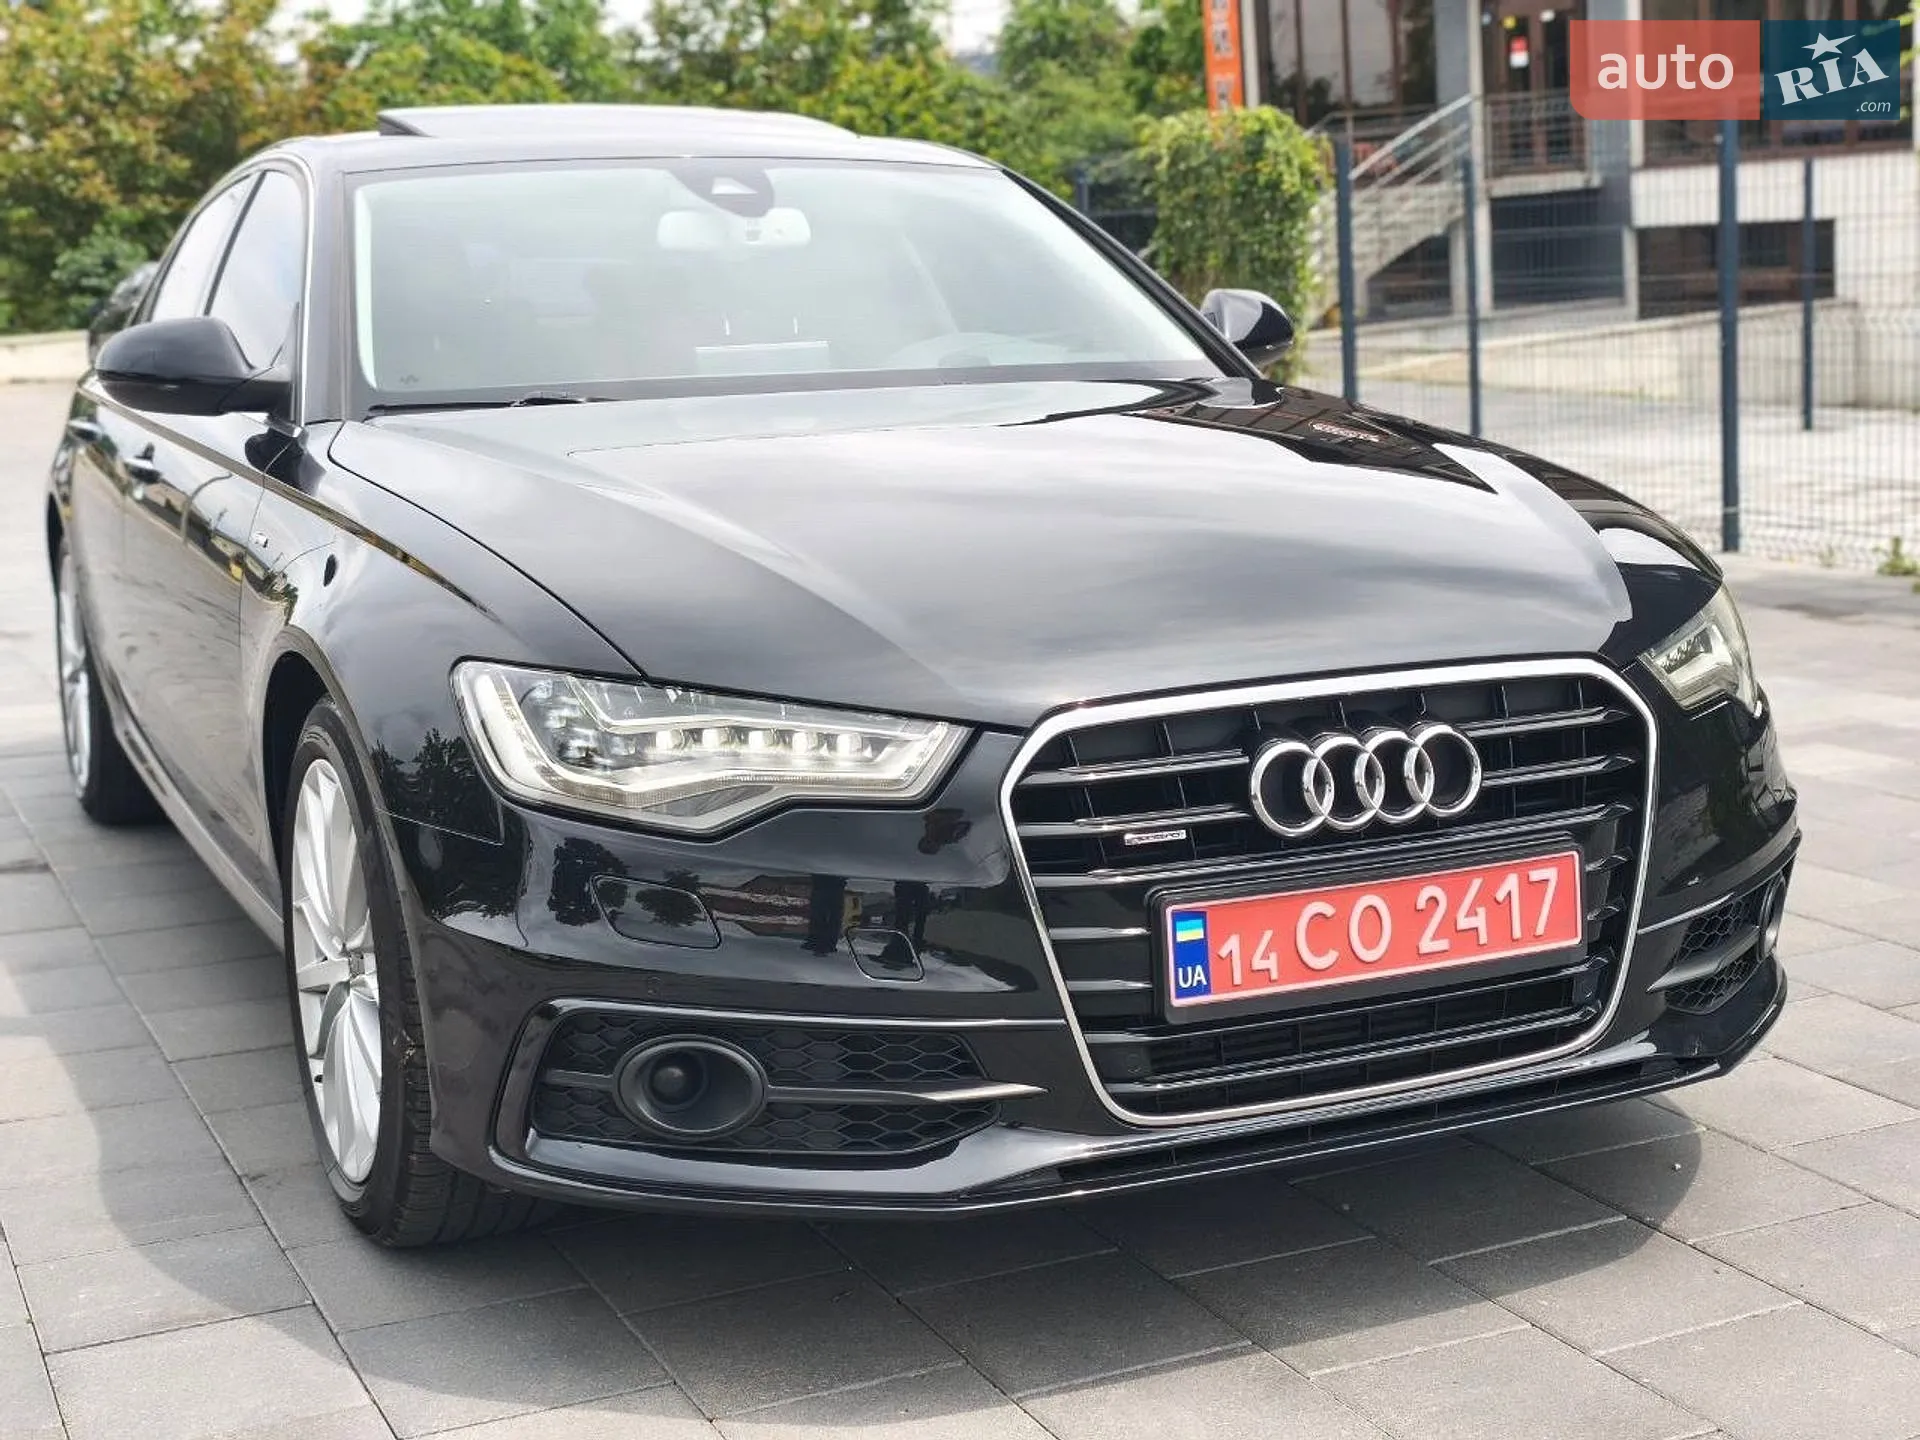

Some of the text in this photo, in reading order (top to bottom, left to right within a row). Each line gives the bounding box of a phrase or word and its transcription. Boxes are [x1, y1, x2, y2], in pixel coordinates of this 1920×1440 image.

[1217, 867, 1558, 986] 14 CO 2417
[1178, 965, 1208, 989] UA
